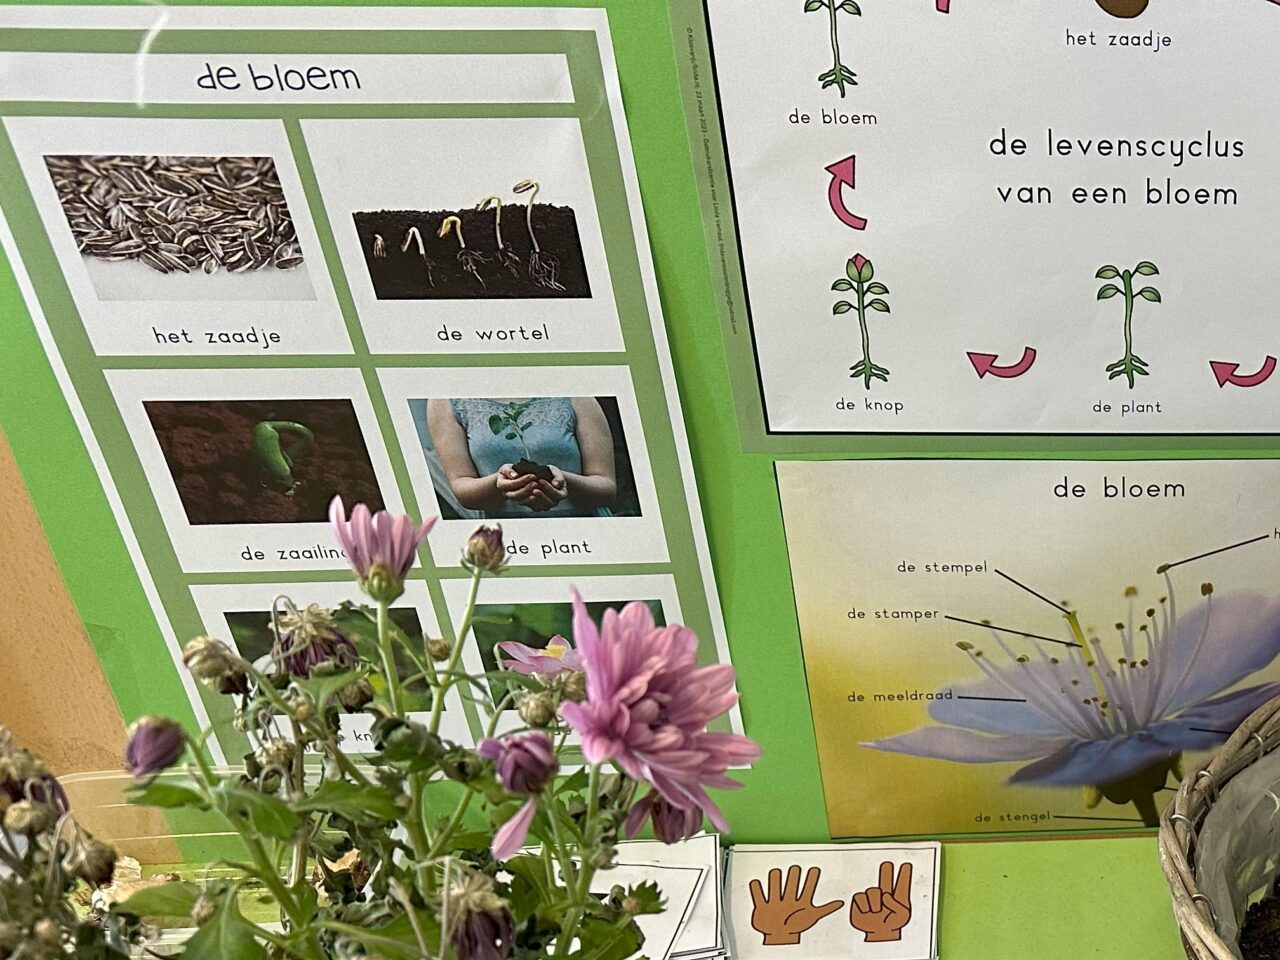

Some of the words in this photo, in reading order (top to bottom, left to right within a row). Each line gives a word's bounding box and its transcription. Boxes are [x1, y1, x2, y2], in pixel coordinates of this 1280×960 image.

[1066, 28, 1097, 46] het
[1108, 29, 1172, 53] zaadje
[197, 62, 241, 90] de
[247, 63, 361, 92] bloem
[788, 107, 811, 124] de
[821, 108, 877, 125] bloem
[989, 127, 1027, 156] de
[1048, 128, 1244, 167] levenscyclus
[996, 186, 1052, 204] van
[1071, 187, 1126, 204] een
[1146, 177, 1237, 205] bloem
[151, 326, 193, 344] het
[204, 326, 281, 349] zaadje
[437, 324, 463, 341] de
[475, 323, 549, 341] wortel
[835, 396, 856, 410] de
[864, 397, 904, 416] knop
[1092, 399, 1112, 413] de
[1121, 399, 1162, 417] plant
[1053, 475, 1086, 498] de
[1103, 476, 1185, 498] bloem
[241, 545, 265, 561] de
[506, 539, 529, 555] de
[540, 538, 592, 560] plant
[897, 560, 916, 573] de
[925, 560, 987, 577] stempel
[847, 607, 866, 619] de
[874, 608, 939, 623] stamper
[847, 690, 865, 703] de
[873, 688, 953, 702] meeldraad
[974, 812, 992, 823] de
[999, 810, 1050, 824] stengel
